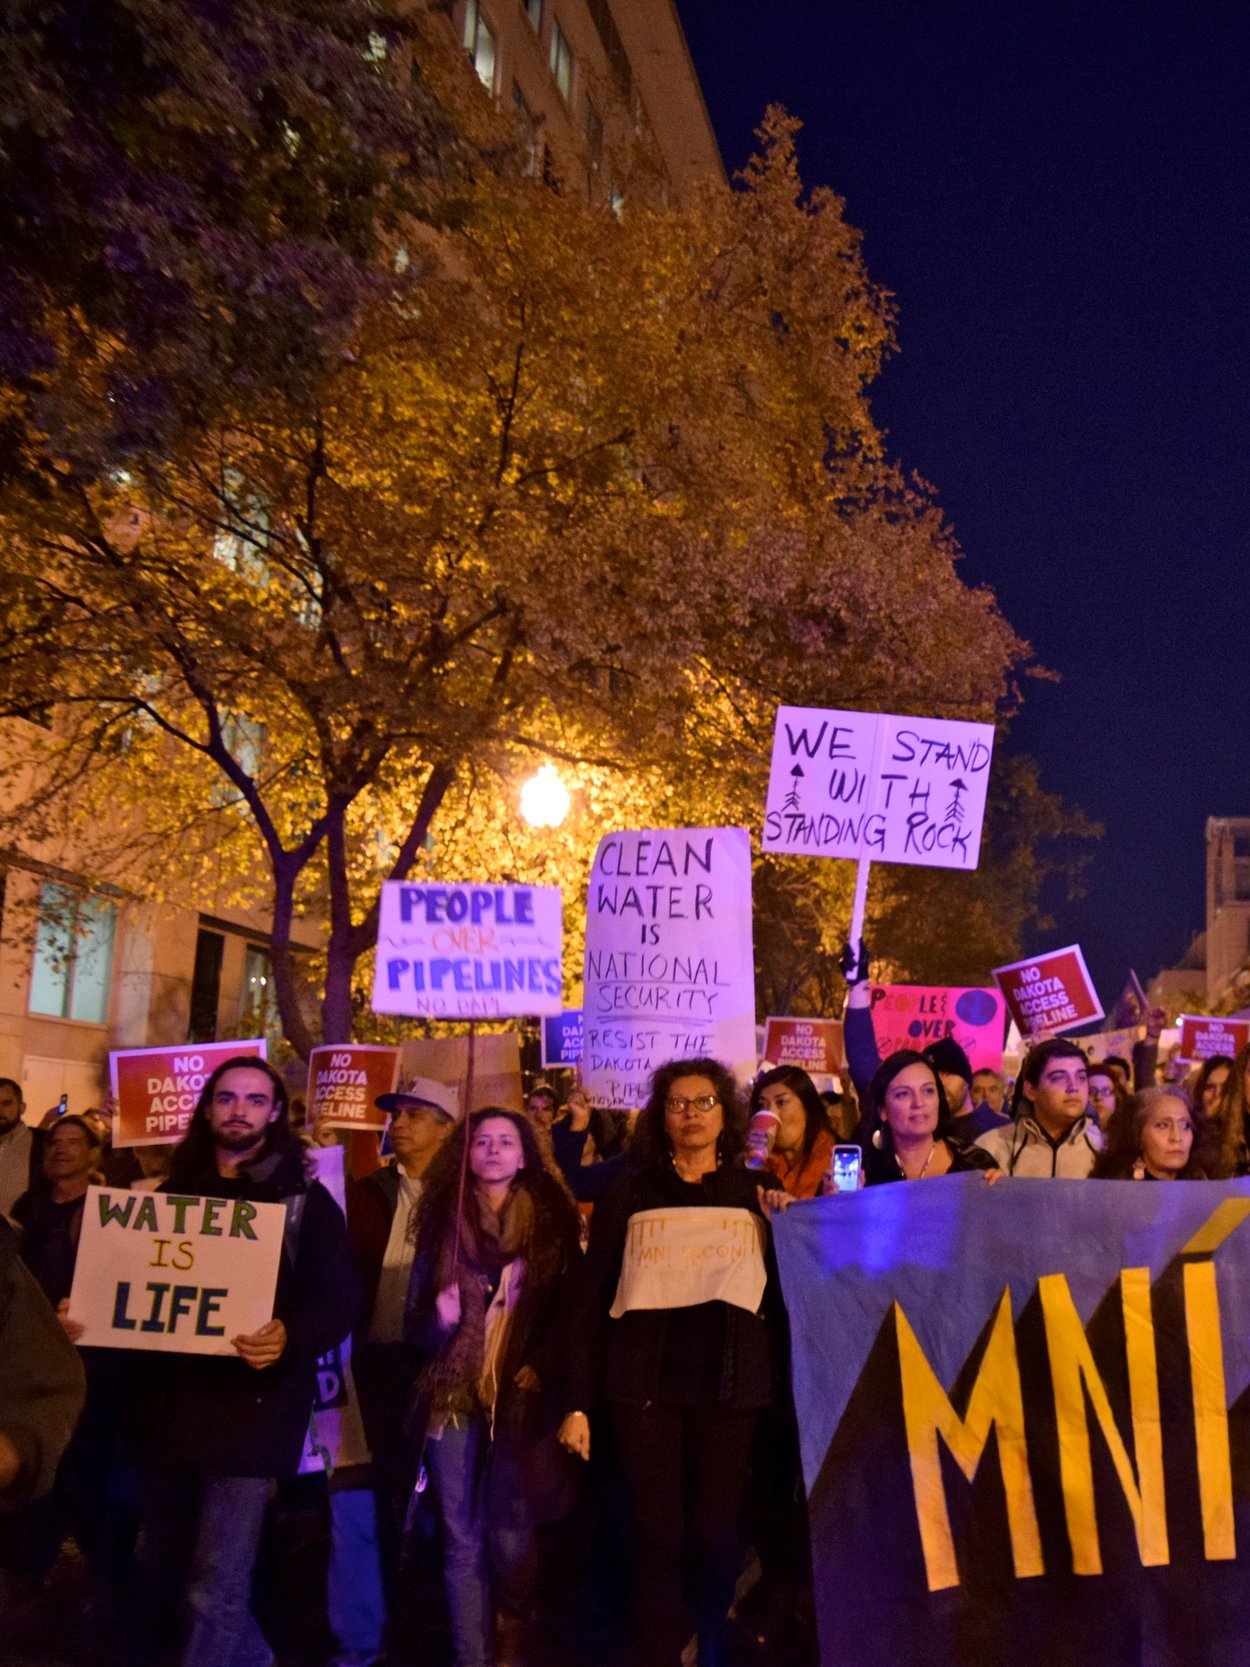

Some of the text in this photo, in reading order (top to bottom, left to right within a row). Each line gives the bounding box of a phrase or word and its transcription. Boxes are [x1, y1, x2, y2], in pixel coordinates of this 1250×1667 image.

[784, 721, 990, 772] WE STAND
[829, 768, 930, 812] WITH
[766, 811, 972, 863] STANDING ROCK
[600, 837, 714, 876] CLEAN
[400, 887, 535, 924] PEOPLE
[598, 883, 715, 920] WATER
[431, 926, 499, 956] OVER
[641, 924, 661, 945] IS
[387, 957, 562, 997] PIPELINES
[587, 951, 731, 986] NATIONAL
[1020, 967, 1041, 983] NO
[596, 985, 719, 1015] SECURITY
[1013, 976, 1065, 1001] DAKOTA
[1020, 991, 1070, 1015] ACCESS
[795, 1025, 813, 1034] NO
[908, 1020, 956, 1038] OVER
[588, 1029, 661, 1051] RESIST
[669, 1033, 715, 1055] THE
[781, 1036, 826, 1048] DAKOTA
[781, 1047, 826, 1059] ACCESS
[174, 1055, 204, 1073] NO
[331, 1053, 351, 1067] NO
[591, 1055, 652, 1072] DAKOTA
[147, 1073, 212, 1094] DAKO
[316, 1069, 368, 1085] DAKOTA
[150, 1094, 200, 1113] ACC
[146, 1113, 192, 1132] PIPE
[98, 1194, 258, 1240] WATER
[150, 1239, 194, 1270] IS
[111, 1281, 228, 1337] LIFE
